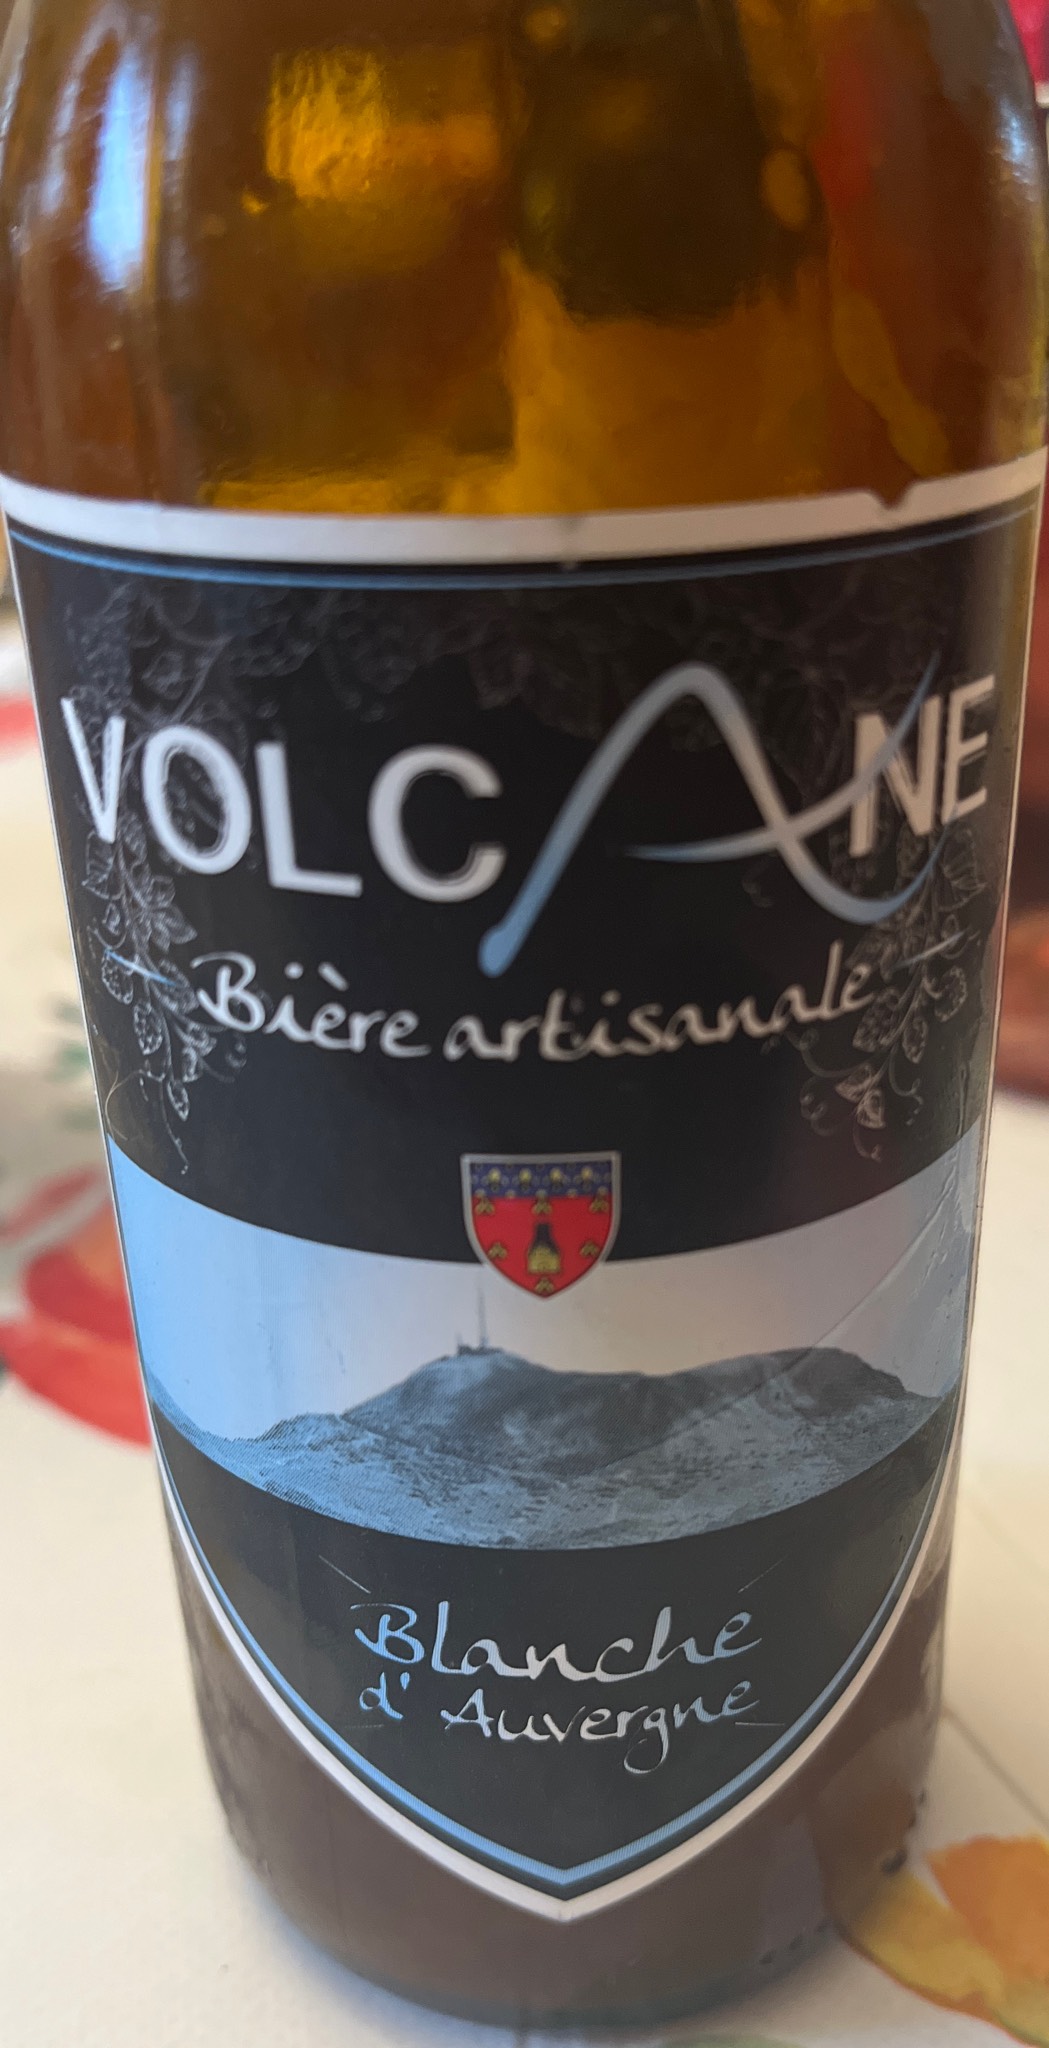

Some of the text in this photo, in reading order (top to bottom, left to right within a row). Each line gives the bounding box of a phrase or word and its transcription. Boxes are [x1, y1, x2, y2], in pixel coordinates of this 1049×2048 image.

[61, 652, 996, 978] VOLCANE
[190, 940, 876, 1061] Bière artisanale
[350, 1601, 762, 1682] Blanche
[359, 1672, 759, 1774] d' Auvergne
